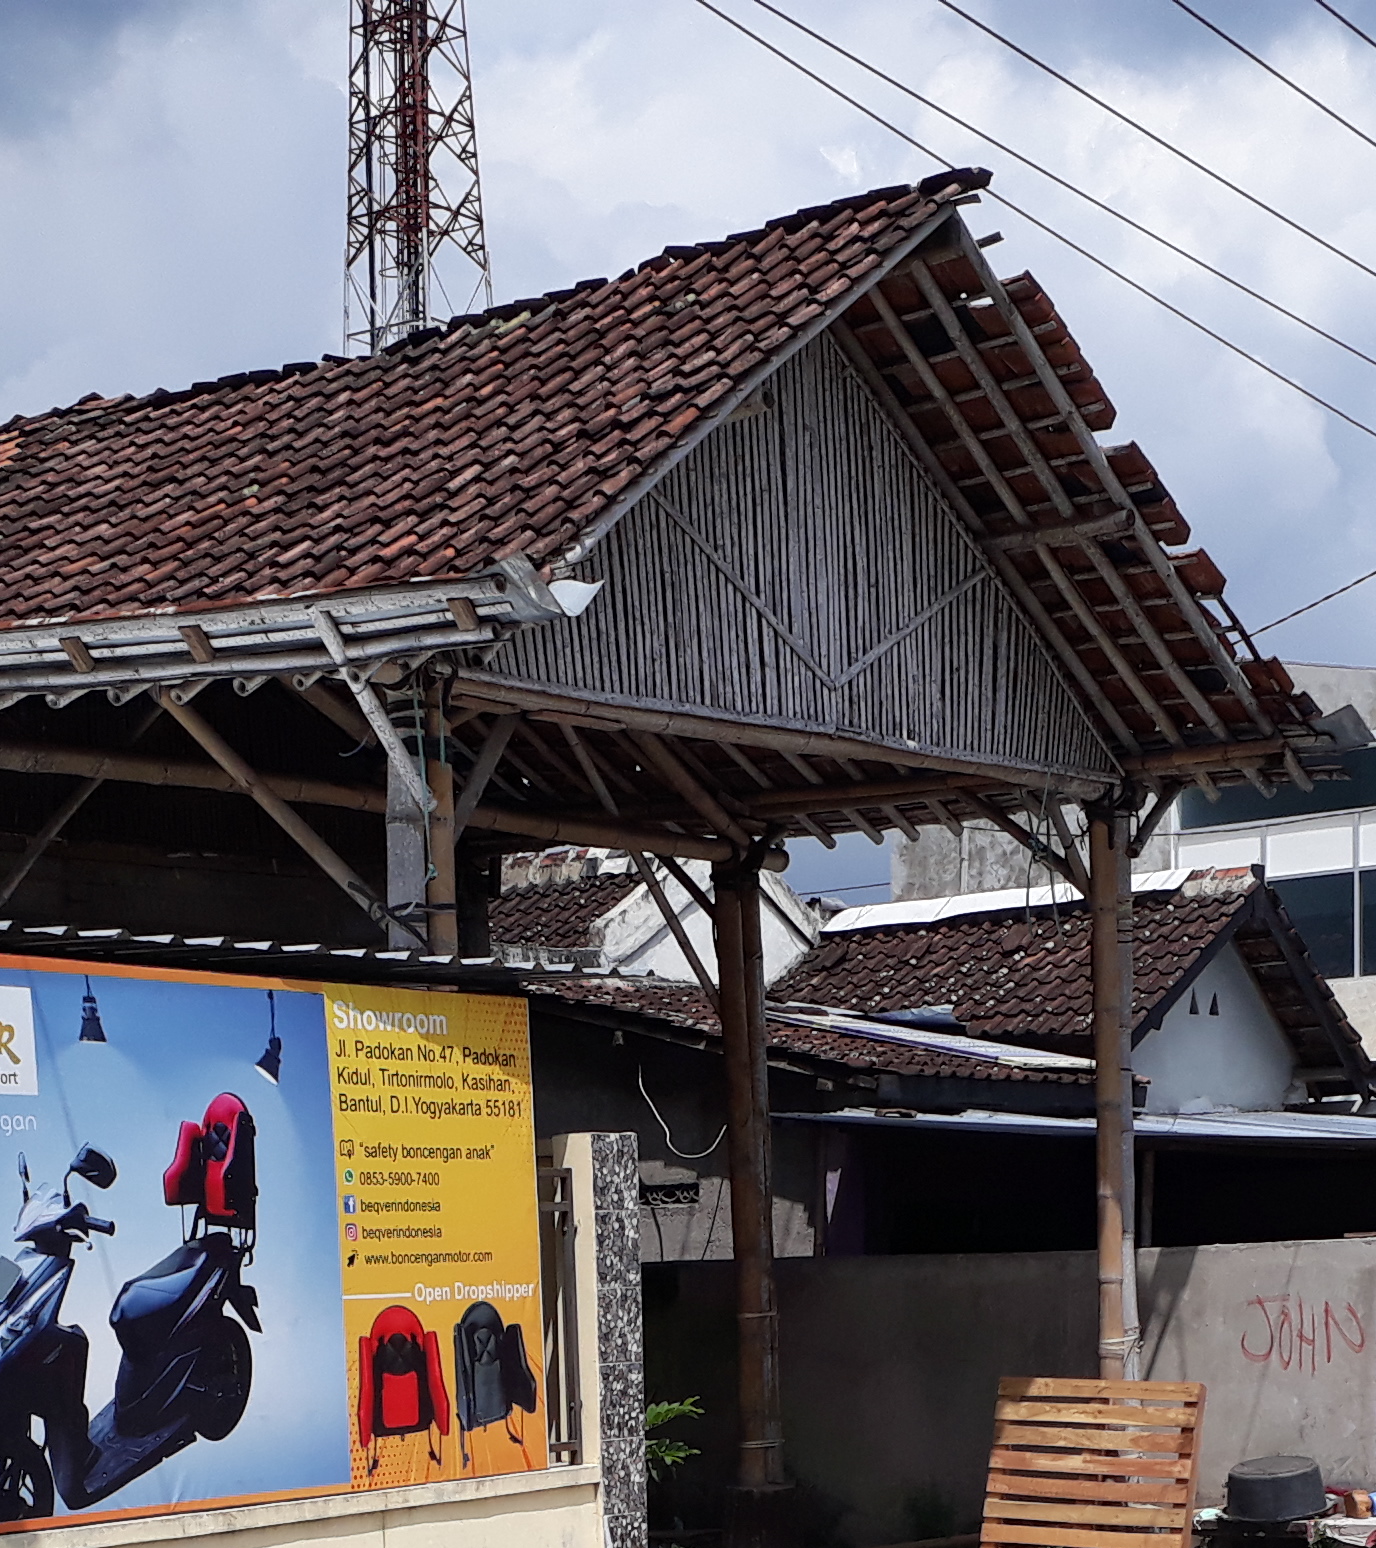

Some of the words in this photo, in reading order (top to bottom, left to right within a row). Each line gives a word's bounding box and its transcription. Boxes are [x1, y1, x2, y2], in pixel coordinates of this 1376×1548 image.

[333, 1000, 448, 1035] Showroom
[336, 1040, 351, 1058] Jl.
[355, 1041, 414, 1062] Padokan
[417, 1044, 459, 1066] No.47,
[463, 1047, 516, 1068] Padokan
[337, 1066, 375, 1088] Kidul,
[379, 1069, 458, 1092] Tirtonirmolo,
[461, 1073, 515, 1094] Kasihan,
[338, 1093, 386, 1116] Bantul,
[390, 1096, 482, 1119] D.I.Yogyakarta
[485, 1099, 522, 1118] 55181
[401, 1144, 462, 1164] boncengan
[359, 1172, 439, 1186] 0853-5900-7400
[361, 1198, 440, 1215] beqverindonesia
[362, 1225, 442, 1241] beqverindonesia
[365, 1251, 492, 1267] www.boncenganmotor.com
[414, 1283, 450, 1305] Open
[454, 1281, 534, 1300] Dropshipper
[1241, 1292, 1365, 1377] JOHN
